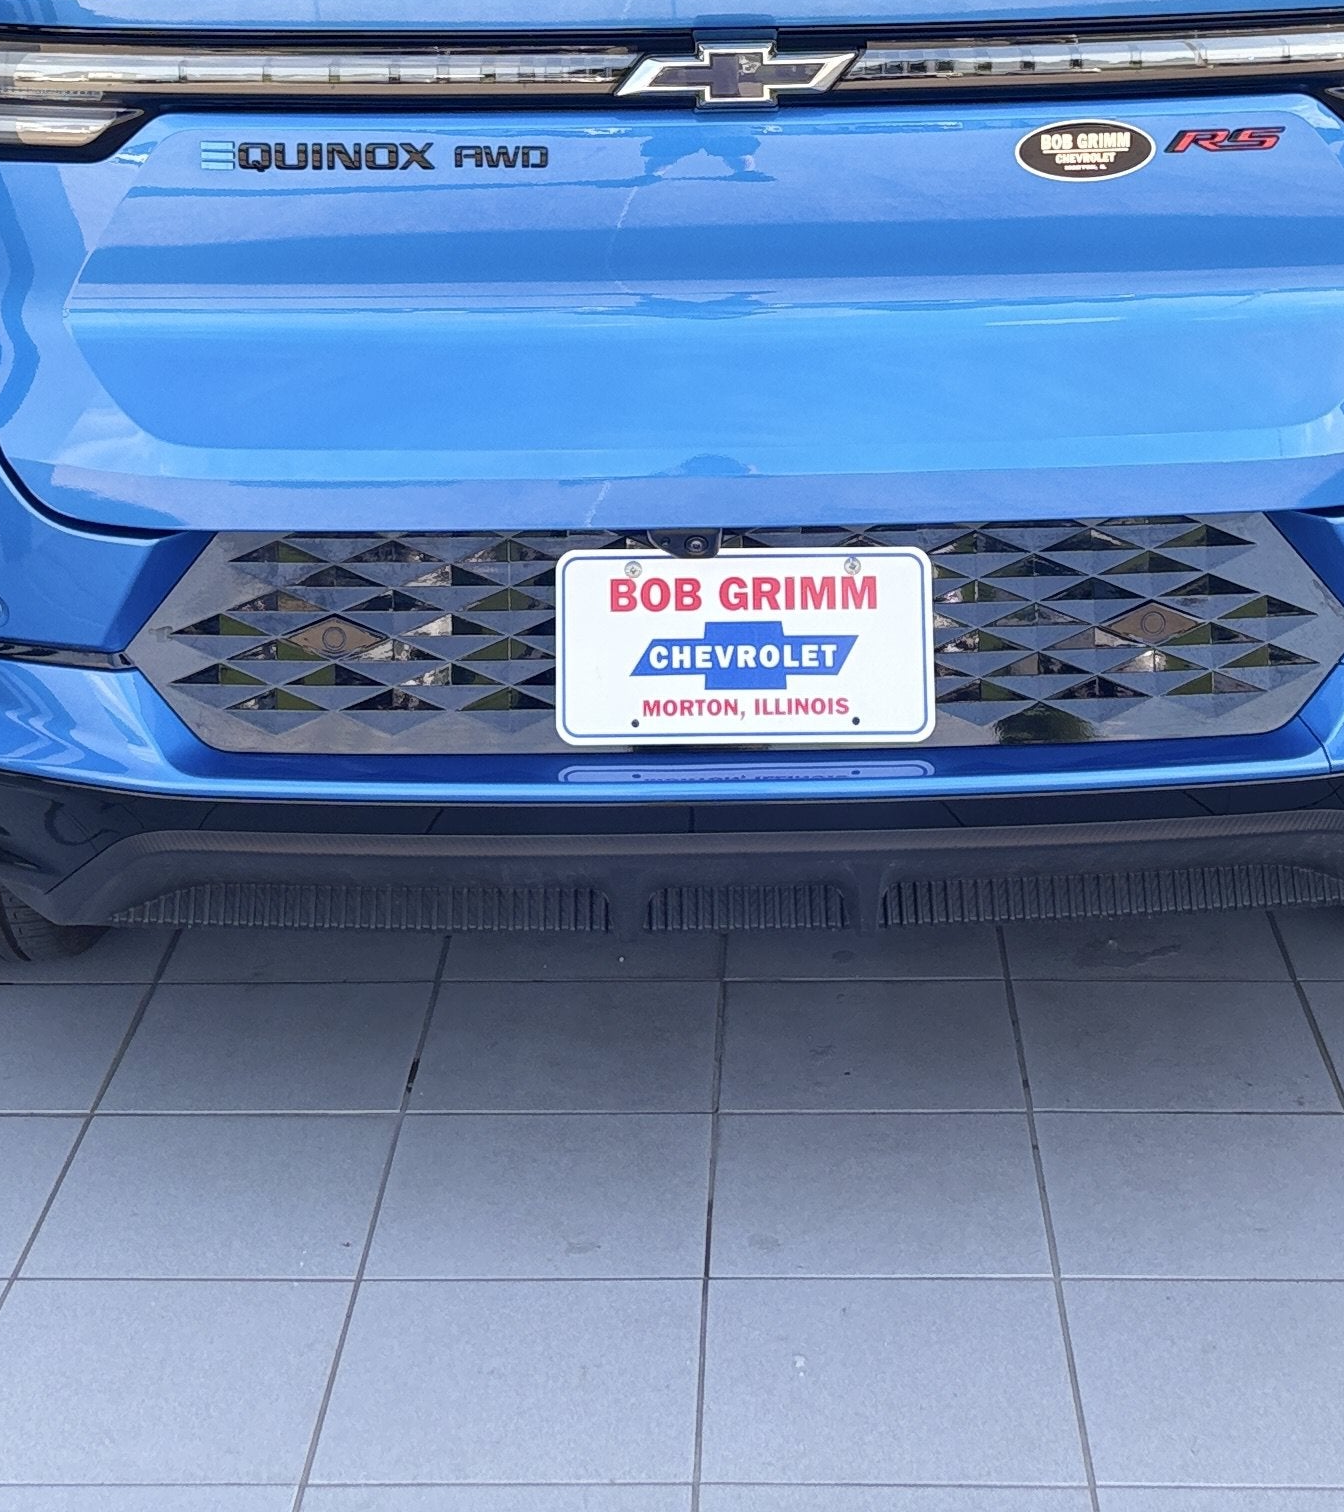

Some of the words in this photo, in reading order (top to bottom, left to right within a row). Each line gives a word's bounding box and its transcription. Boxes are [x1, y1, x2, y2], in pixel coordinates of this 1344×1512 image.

[1040, 133, 1073, 150] BOB
[1077, 132, 1131, 149] GRIMM
[1163, 126, 1286, 154] RS
[201, 140, 435, 172] EQUINOX
[454, 145, 549, 168] AWD
[1055, 152, 1116, 164] CHEVROLET
[609, 577, 703, 613] BOB
[719, 575, 878, 611] GRIMM
[648, 643, 838, 670] CHEVROLET
[642, 699, 747, 721] MORTON,
[755, 697, 851, 716] ILLINOIS
